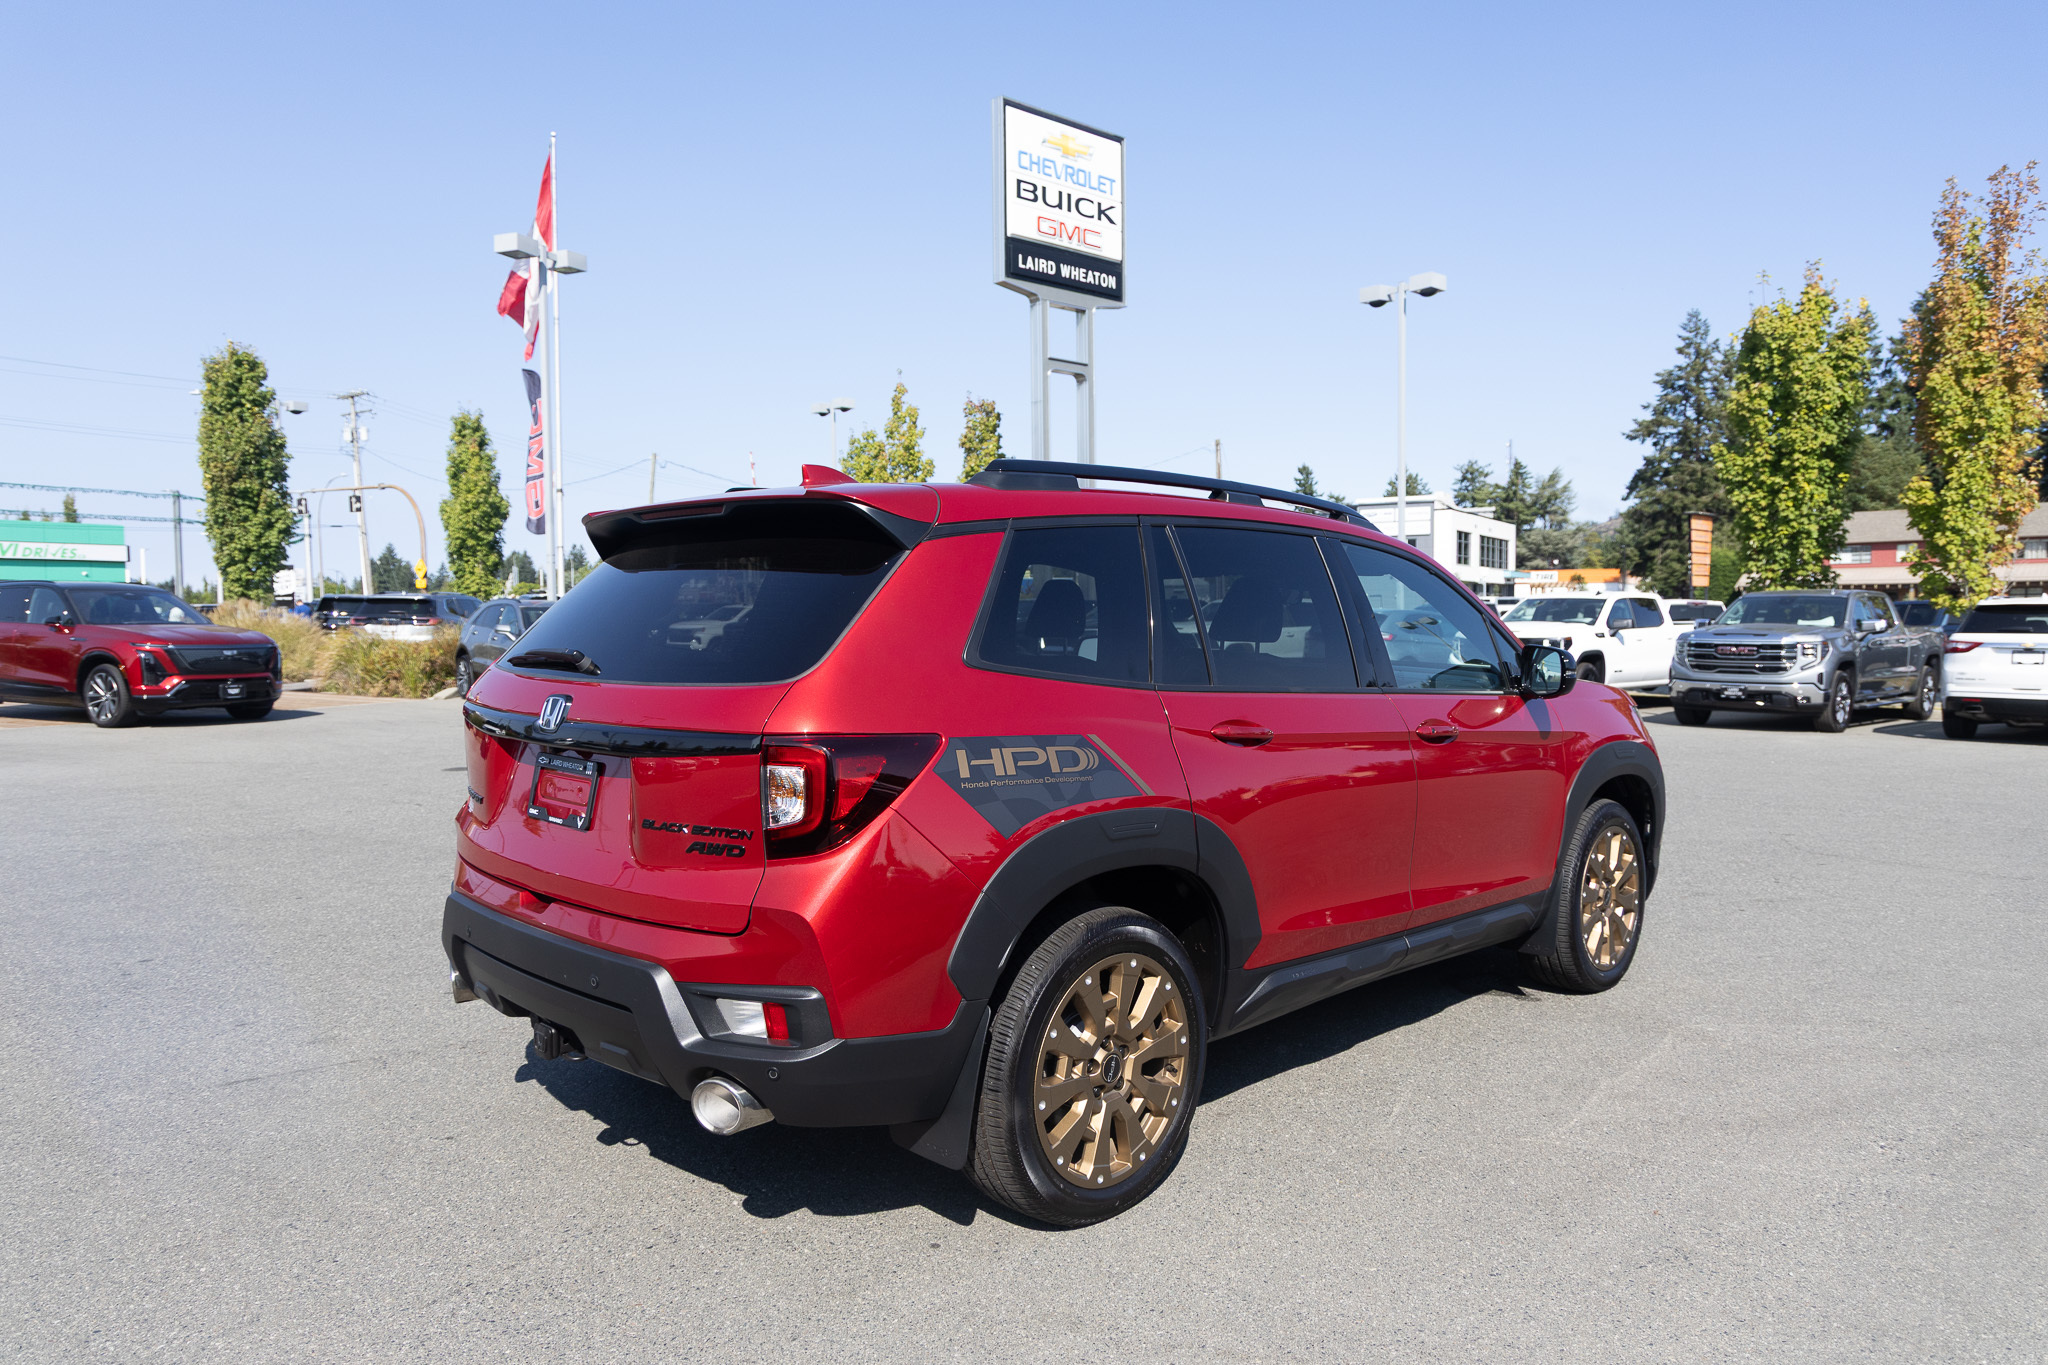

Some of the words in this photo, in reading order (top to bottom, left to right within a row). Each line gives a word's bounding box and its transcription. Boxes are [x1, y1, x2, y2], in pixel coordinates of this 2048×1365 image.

[1017, 150, 1116, 196] CHEVROLET
[1016, 178, 1117, 226] BUICK
[1037, 215, 1102, 250] GMC
[1018, 253, 1056, 275] LAIRD
[1060, 263, 1117, 290] WHEATON
[955, 746, 1100, 779] HPD
[961, 779, 989, 789] Honda
[990, 777, 1044, 788] Performance
[1044, 775, 1094, 785] Development
[641, 818, 690, 834] BLACK
[691, 825, 755, 841] EDITION
[685, 841, 746, 858] AWD
